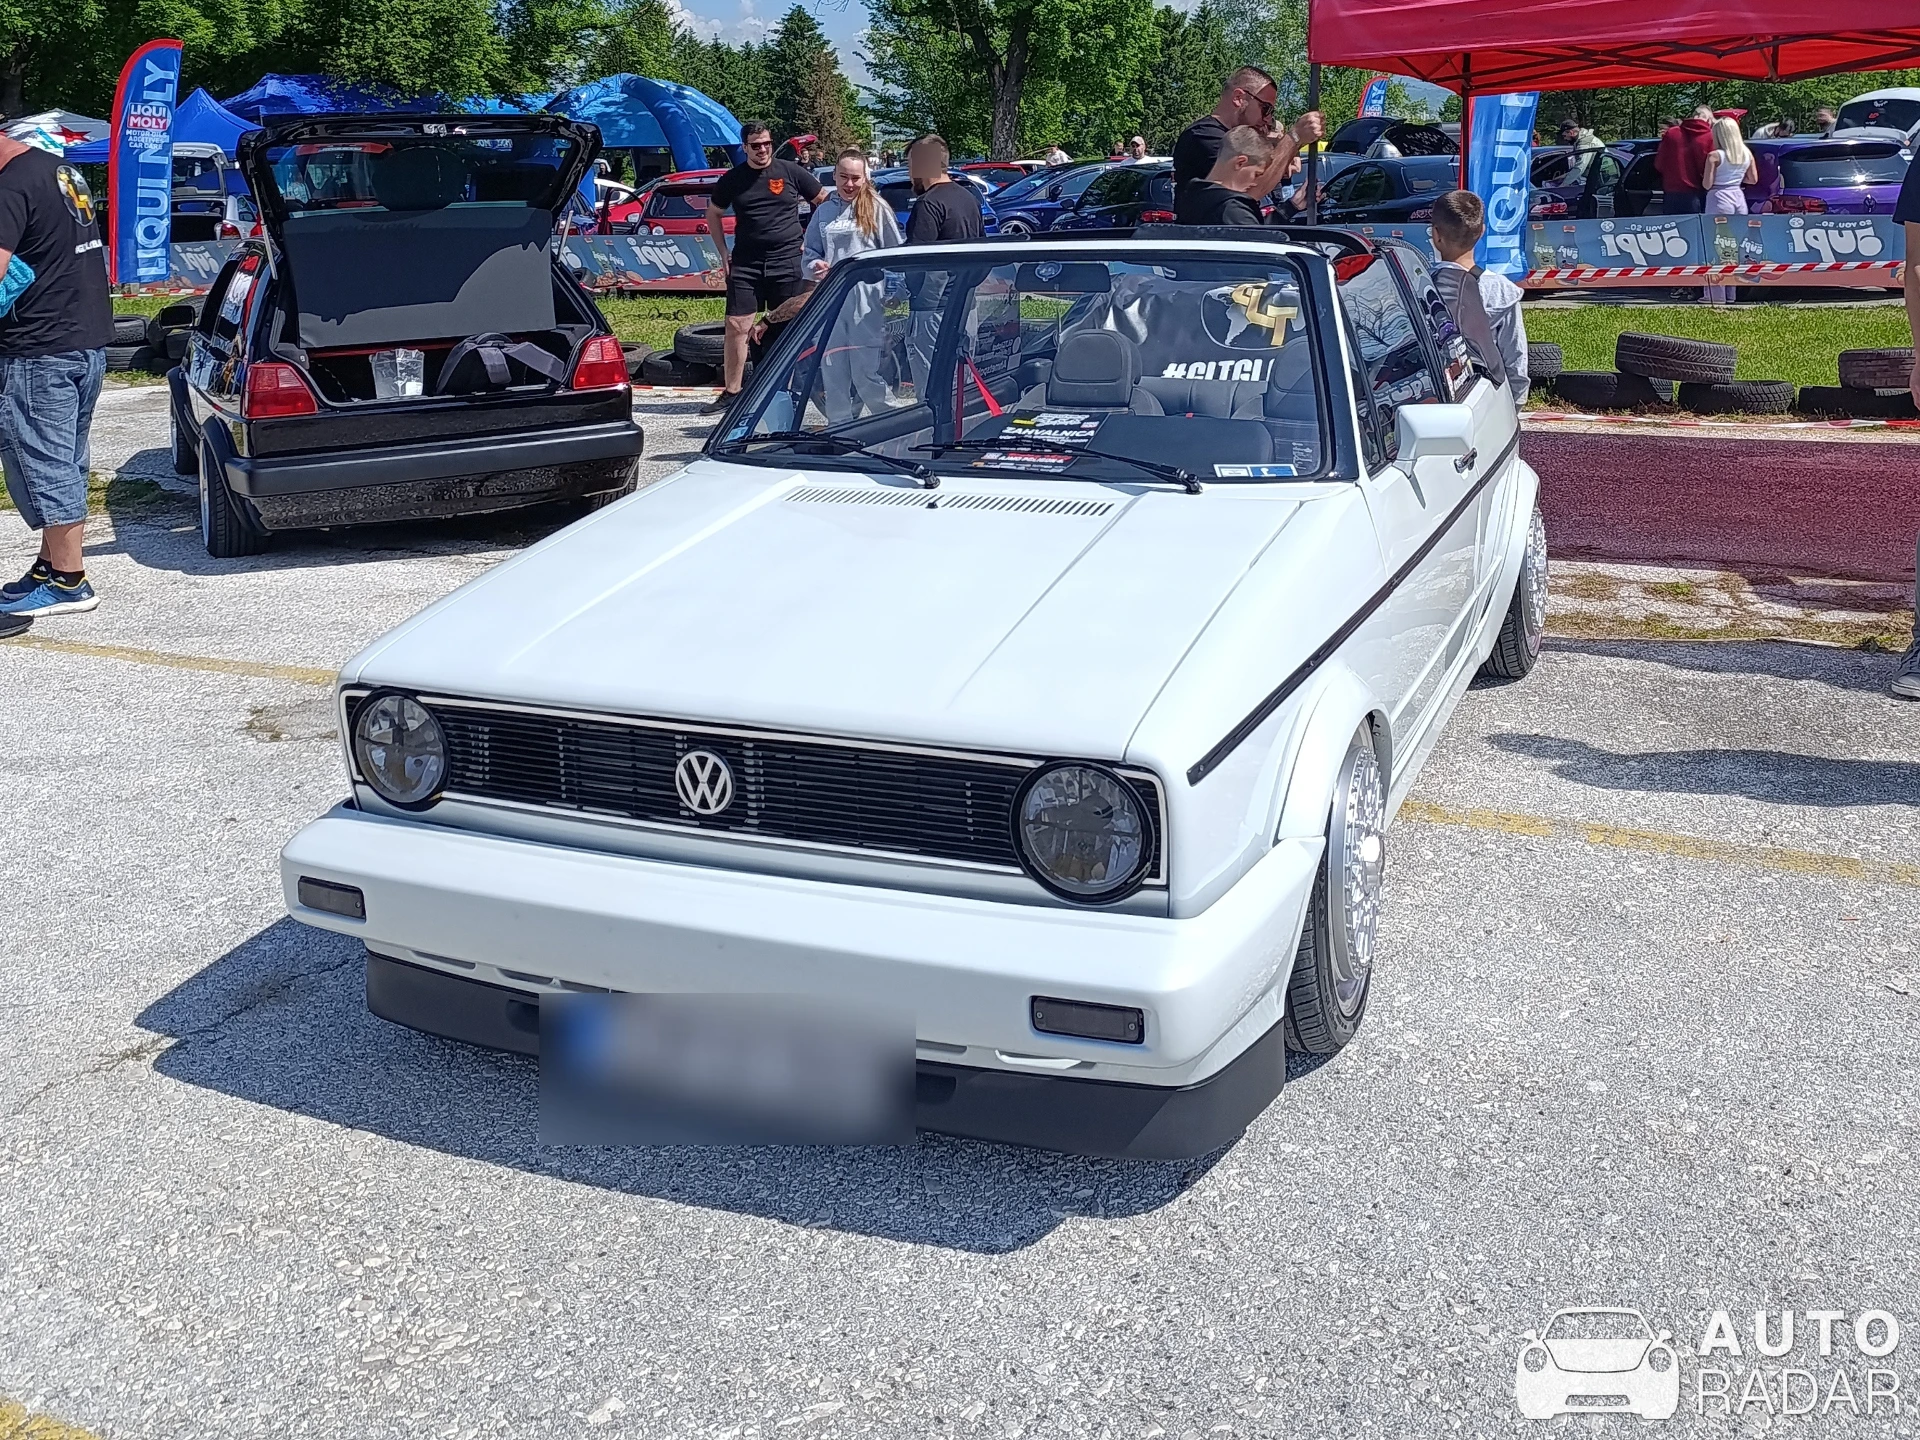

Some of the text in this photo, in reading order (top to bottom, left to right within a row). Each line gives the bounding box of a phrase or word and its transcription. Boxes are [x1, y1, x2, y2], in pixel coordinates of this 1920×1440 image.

[130, 116, 167, 129] MOLY
[131, 104, 167, 117] LIQUI
[1485, 129, 1528, 274] LIQUI
[136, 177, 170, 277] LIQUI
[1002, 426, 1095, 437] ZAHVALNICA
[675, 751, 732, 814] VW
